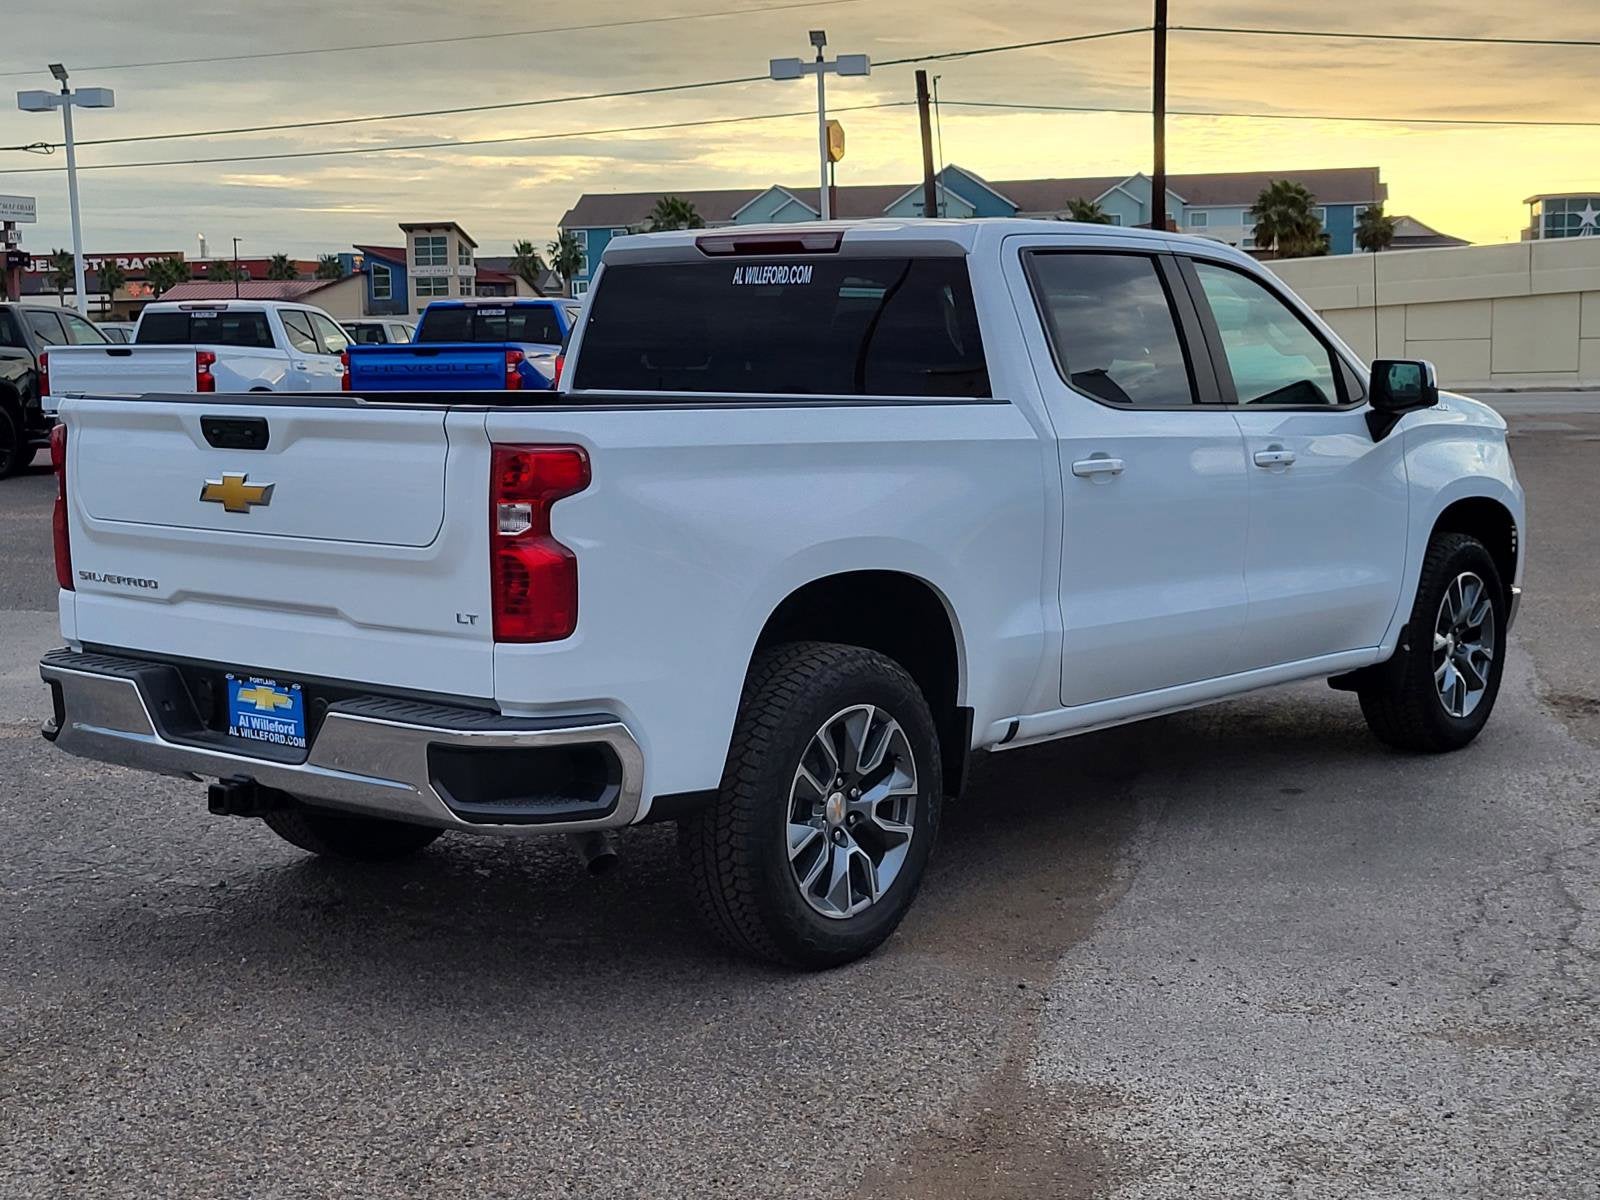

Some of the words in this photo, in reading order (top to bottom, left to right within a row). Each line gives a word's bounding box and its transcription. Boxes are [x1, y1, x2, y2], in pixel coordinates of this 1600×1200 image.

[24, 259, 60, 272] SEL
[732, 266, 744, 285] AL
[745, 265, 813, 284] WILLEFORD.COM
[360, 363, 493, 374] CHEVROLET
[78, 570, 159, 590] SILVERADO
[456, 612, 479, 626] LT
[249, 676, 276, 687] PORTLAND
[239, 715, 250, 728] Al
[250, 716, 296, 736] Willeford
[229, 725, 240, 737] AL
[240, 727, 306, 748] WILLEFORD.COM
